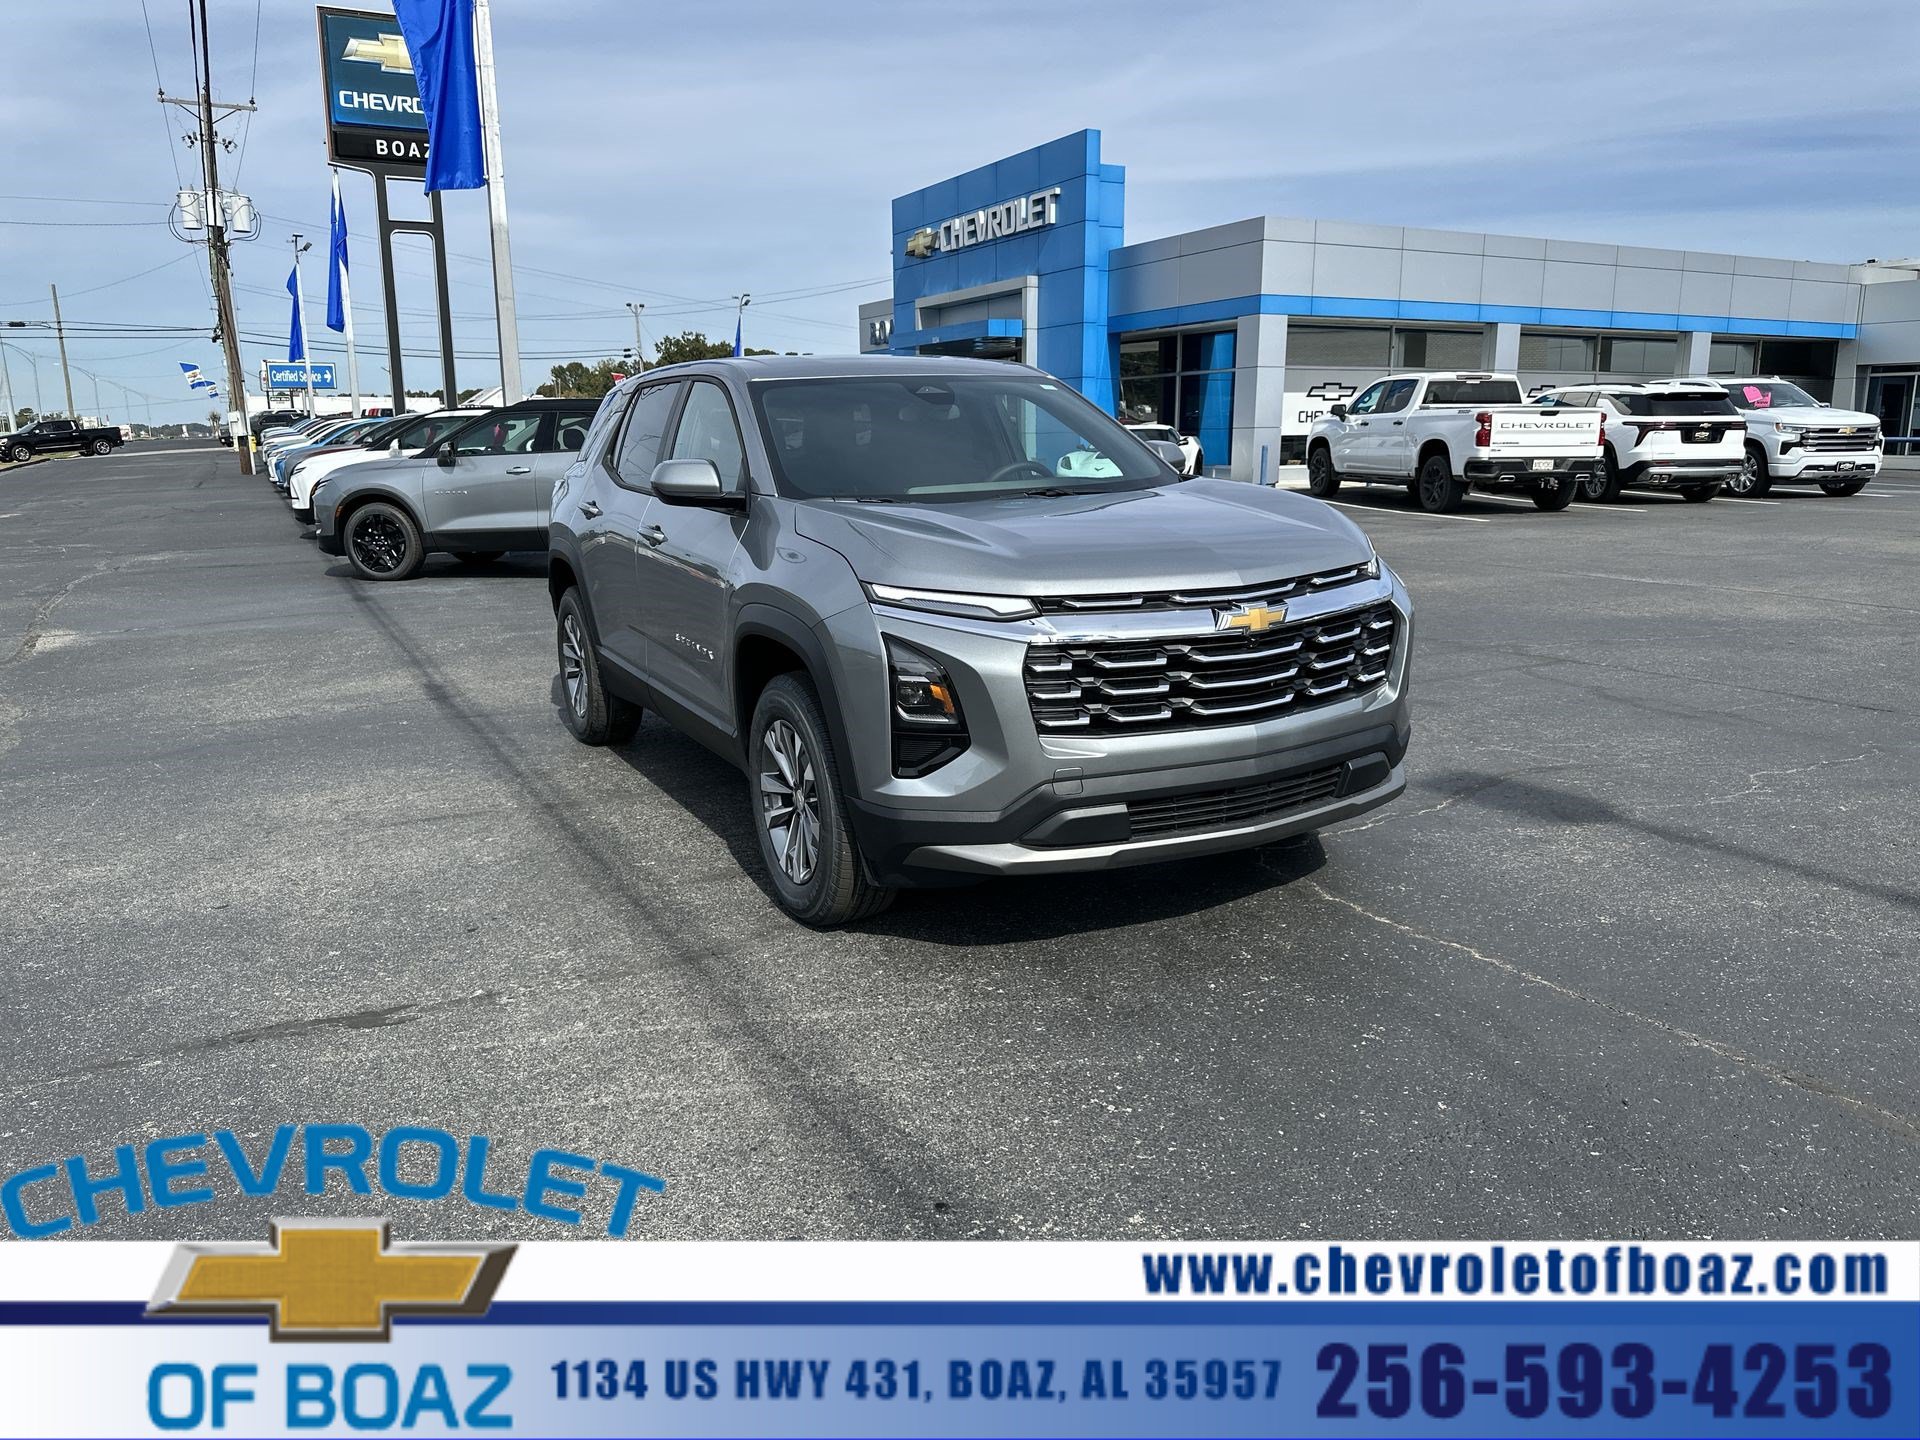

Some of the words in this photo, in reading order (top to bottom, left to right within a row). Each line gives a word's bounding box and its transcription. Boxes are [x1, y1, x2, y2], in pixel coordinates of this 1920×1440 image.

[339, 90, 424, 114] CHEVRO
[940, 187, 1061, 253] CHEVROLET
[271, 370, 298, 382] Certified
[299, 370, 322, 382] Seice
